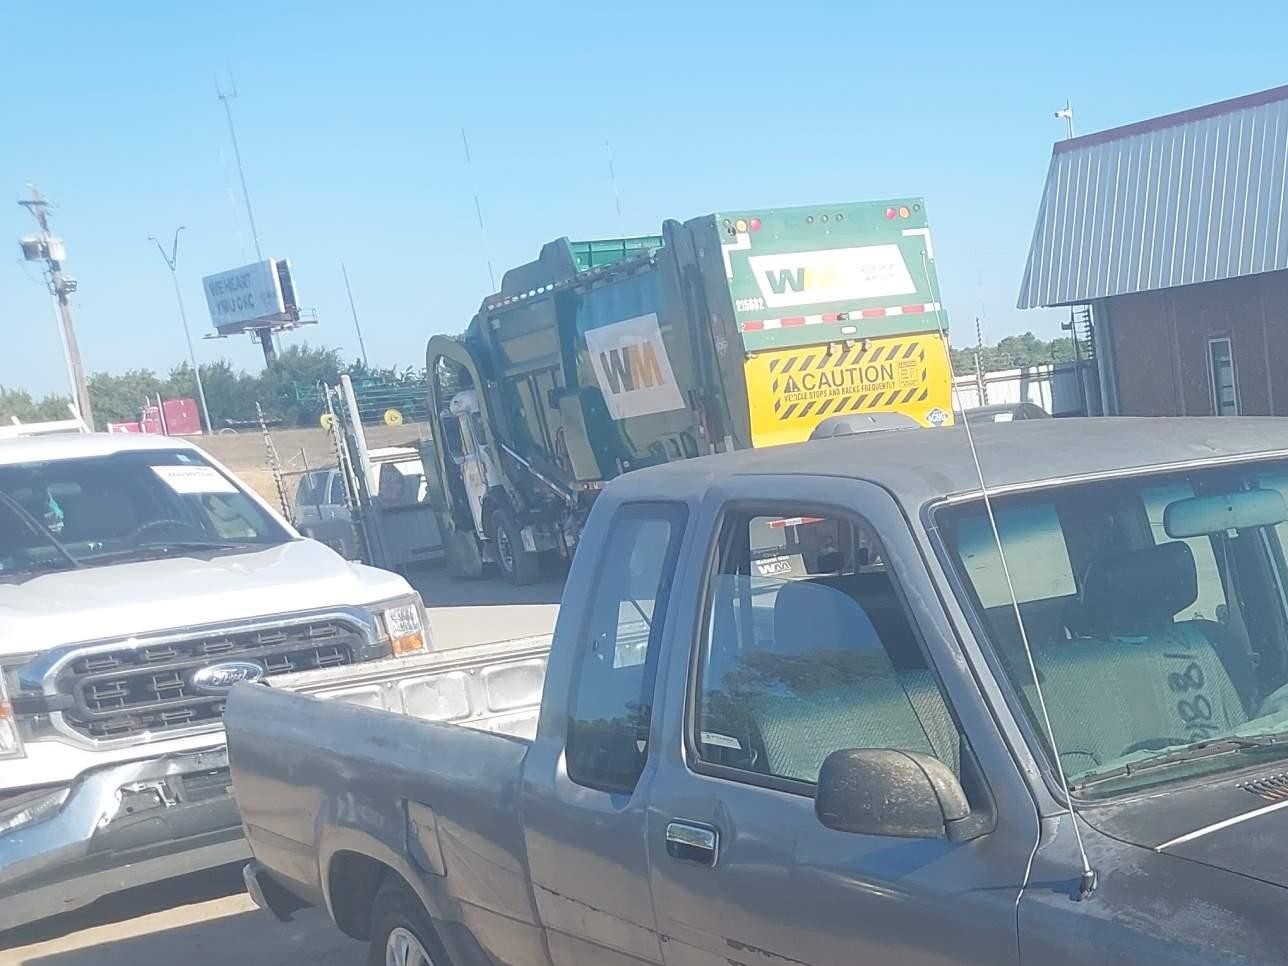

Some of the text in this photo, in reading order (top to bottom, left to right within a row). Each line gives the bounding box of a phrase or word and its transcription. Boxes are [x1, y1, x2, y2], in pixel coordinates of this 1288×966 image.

[599, 341, 665, 394] WM
[802, 362, 894, 391] CAUTION
[809, 390, 828, 400] STOPS
[828, 388, 841, 397] AND
[841, 385, 861, 395] BACKS
